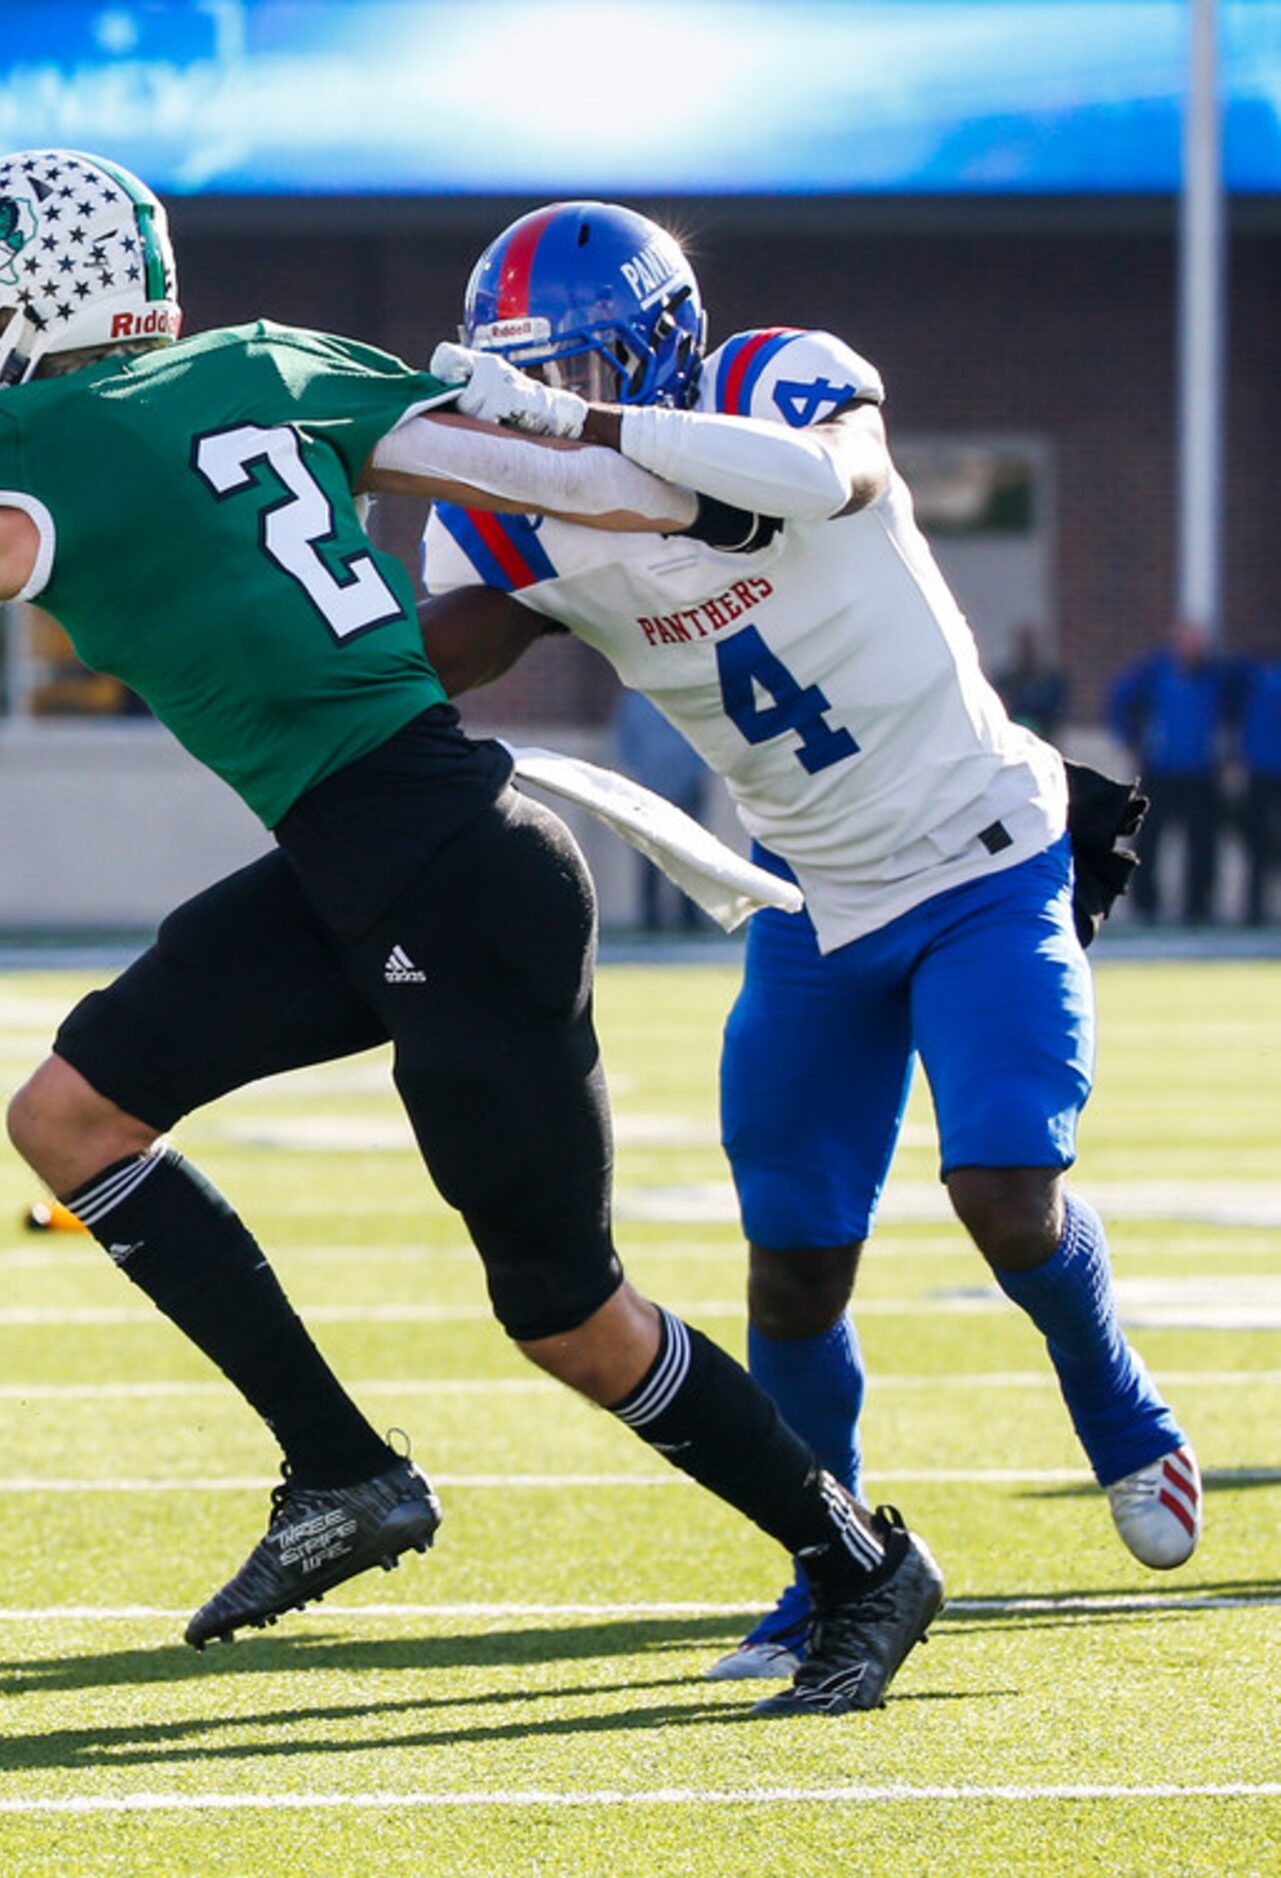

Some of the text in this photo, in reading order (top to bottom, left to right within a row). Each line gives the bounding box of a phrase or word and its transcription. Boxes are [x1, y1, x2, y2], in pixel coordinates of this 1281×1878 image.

[111, 309, 183, 339] Ridd
[772, 376, 857, 429] 4
[189, 420, 409, 648] 2
[637, 576, 775, 646] PANTHERS
[715, 622, 862, 776] 4
[384, 970, 427, 983] adidas
